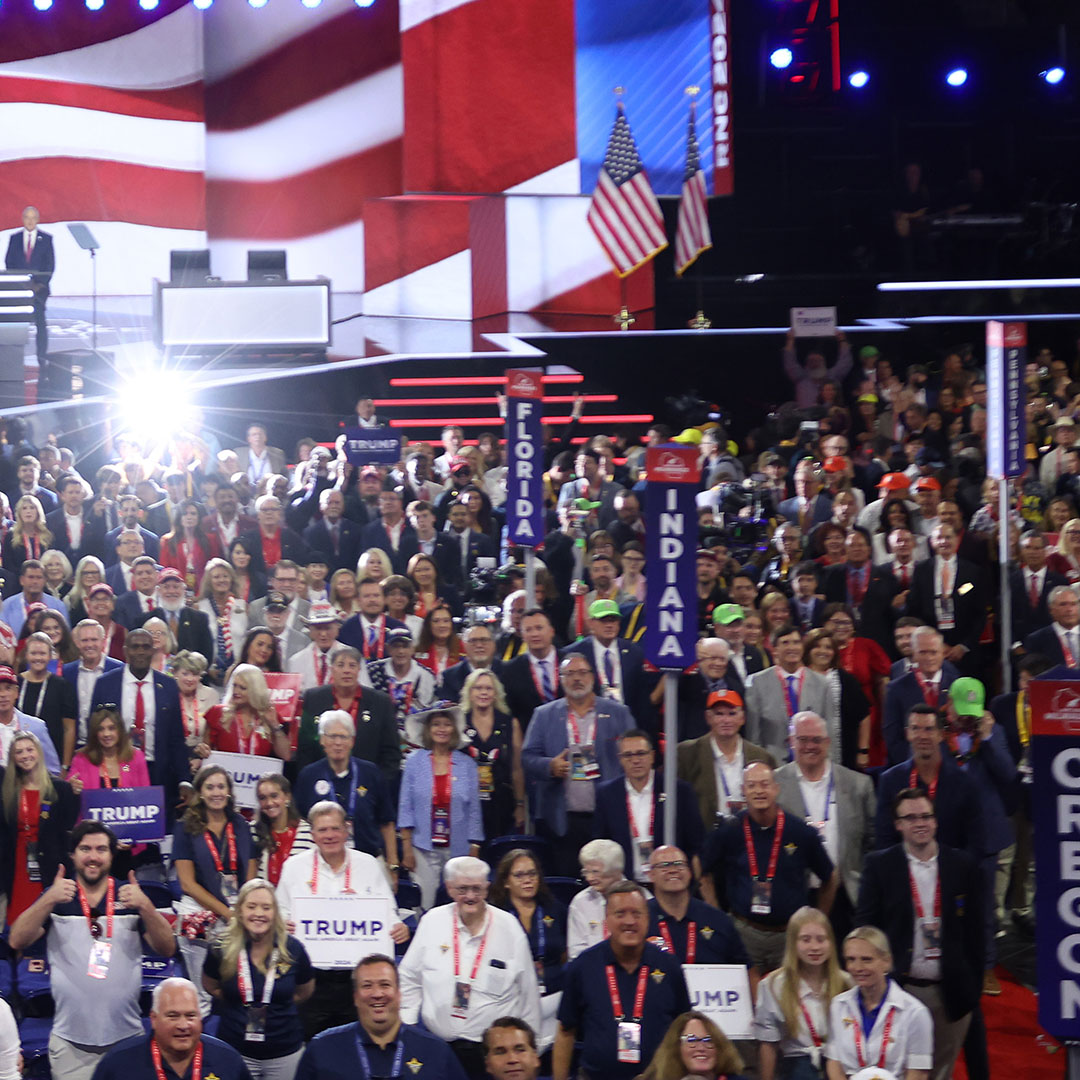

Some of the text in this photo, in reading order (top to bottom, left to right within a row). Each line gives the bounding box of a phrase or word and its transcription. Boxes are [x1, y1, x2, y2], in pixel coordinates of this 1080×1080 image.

[713, 90, 729, 167] RNC
[349, 438, 399, 450] TRUMP
[515, 402, 535, 538] FLORIDA
[659, 488, 684, 657] INDIANA
[88, 804, 160, 821] TRUMP
[301, 919, 383, 936] TRUMP
